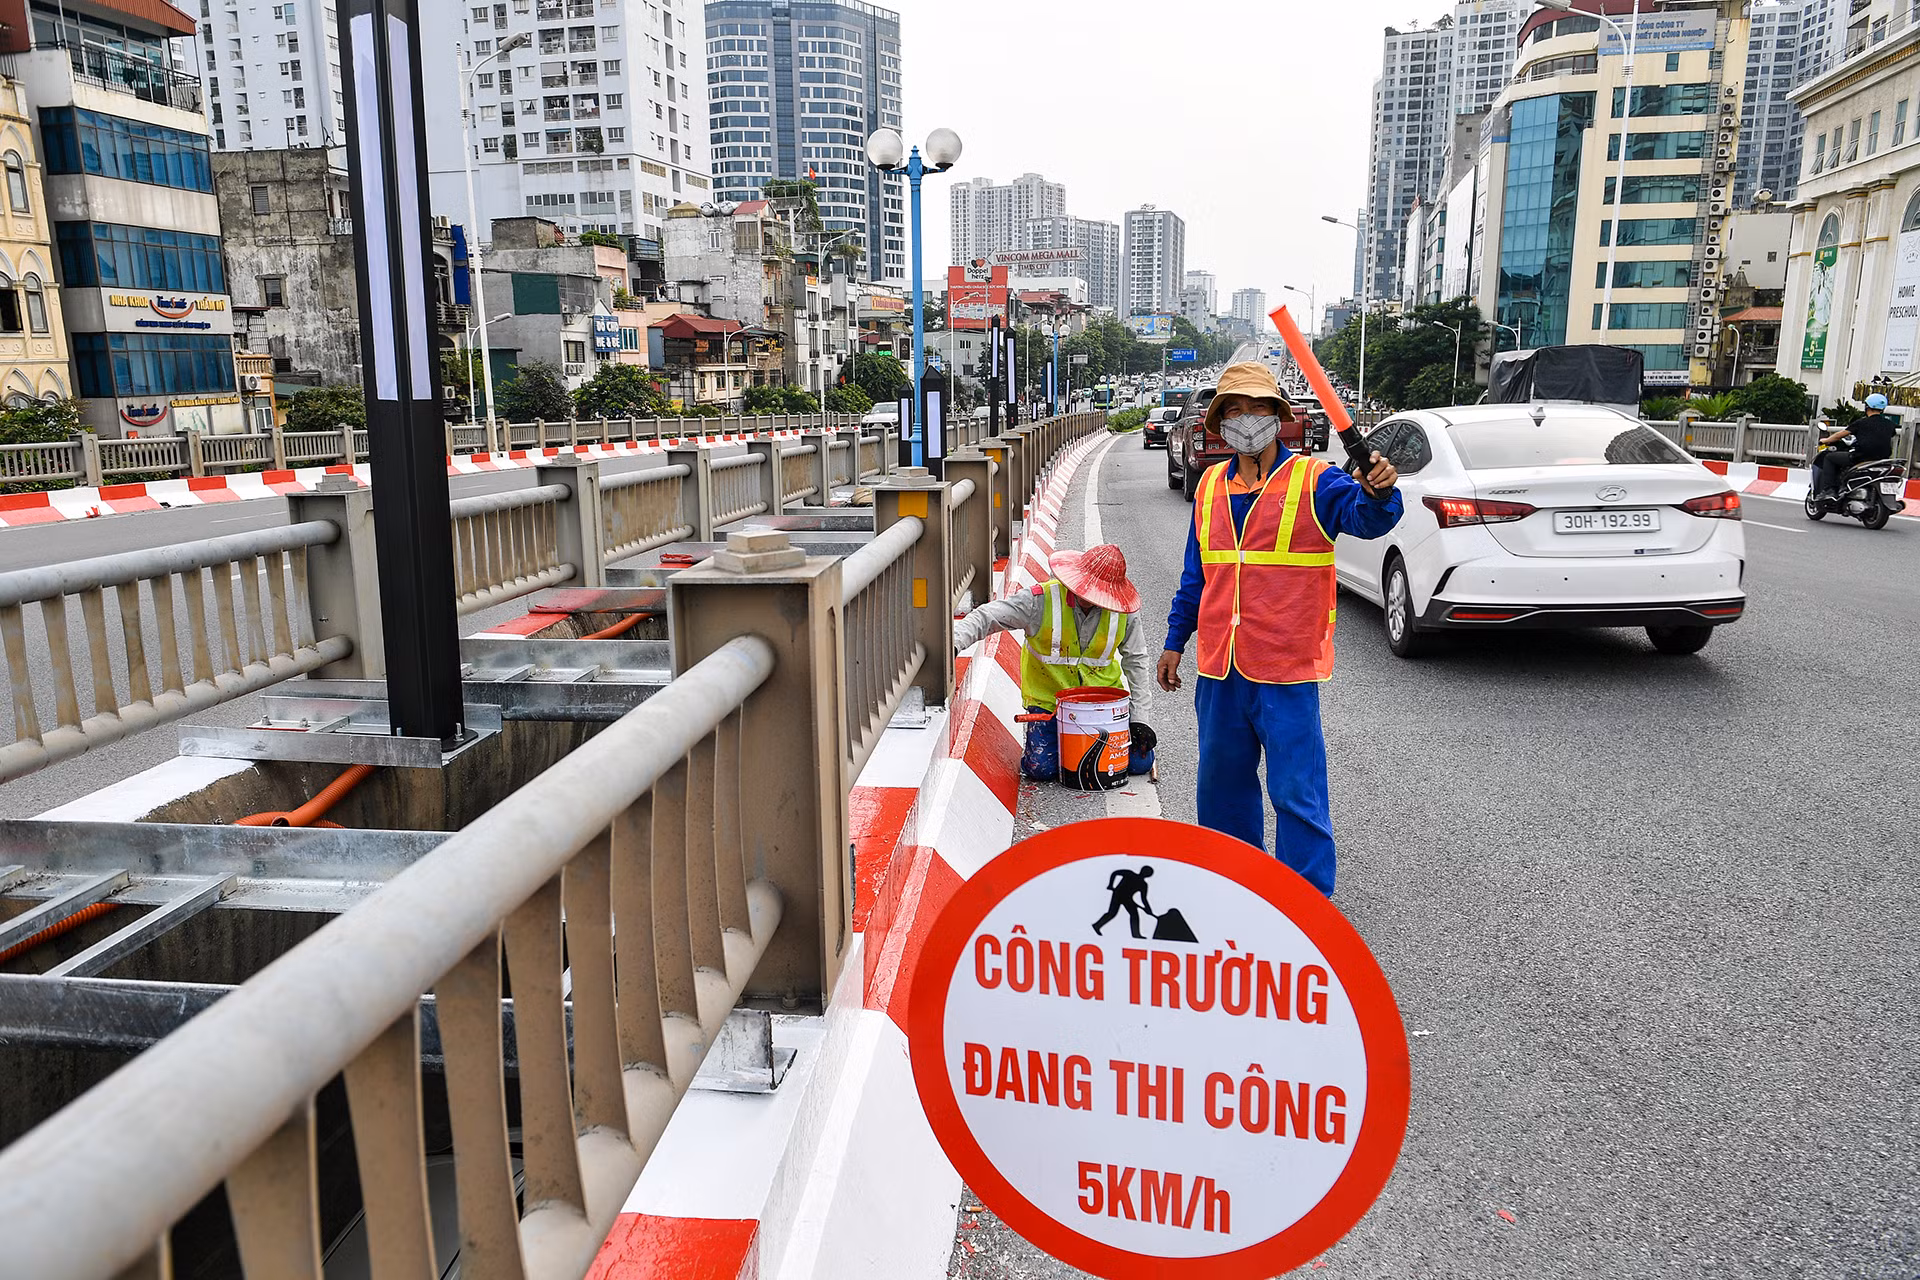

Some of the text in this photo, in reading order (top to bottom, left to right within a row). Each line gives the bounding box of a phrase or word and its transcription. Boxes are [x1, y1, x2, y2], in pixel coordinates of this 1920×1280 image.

[1656, 21, 1675, 29] CÔNG
[1661, 29, 1680, 38] CÔNG
[1681, 28, 1707, 37] NGHIỆP
[996, 249, 1080, 263] VINCOM MEGA MALL
[967, 267, 989, 275] Doppel
[1035, 263, 1051, 271] CITY
[1898, 285, 1916, 298] HOMIE
[110, 295, 127, 306] NHA
[128, 296, 149, 307] KHOA
[1889, 305, 1918, 318] PRESCHOOL
[1564, 514, 1651, 529] 30H-192.99
[975, 925, 1328, 1025] CÔNG TRƯỜNG
[963, 1042, 1347, 1145] ĐANG THI CÔNG
[1077, 1161, 1232, 1234] 5KM/h
